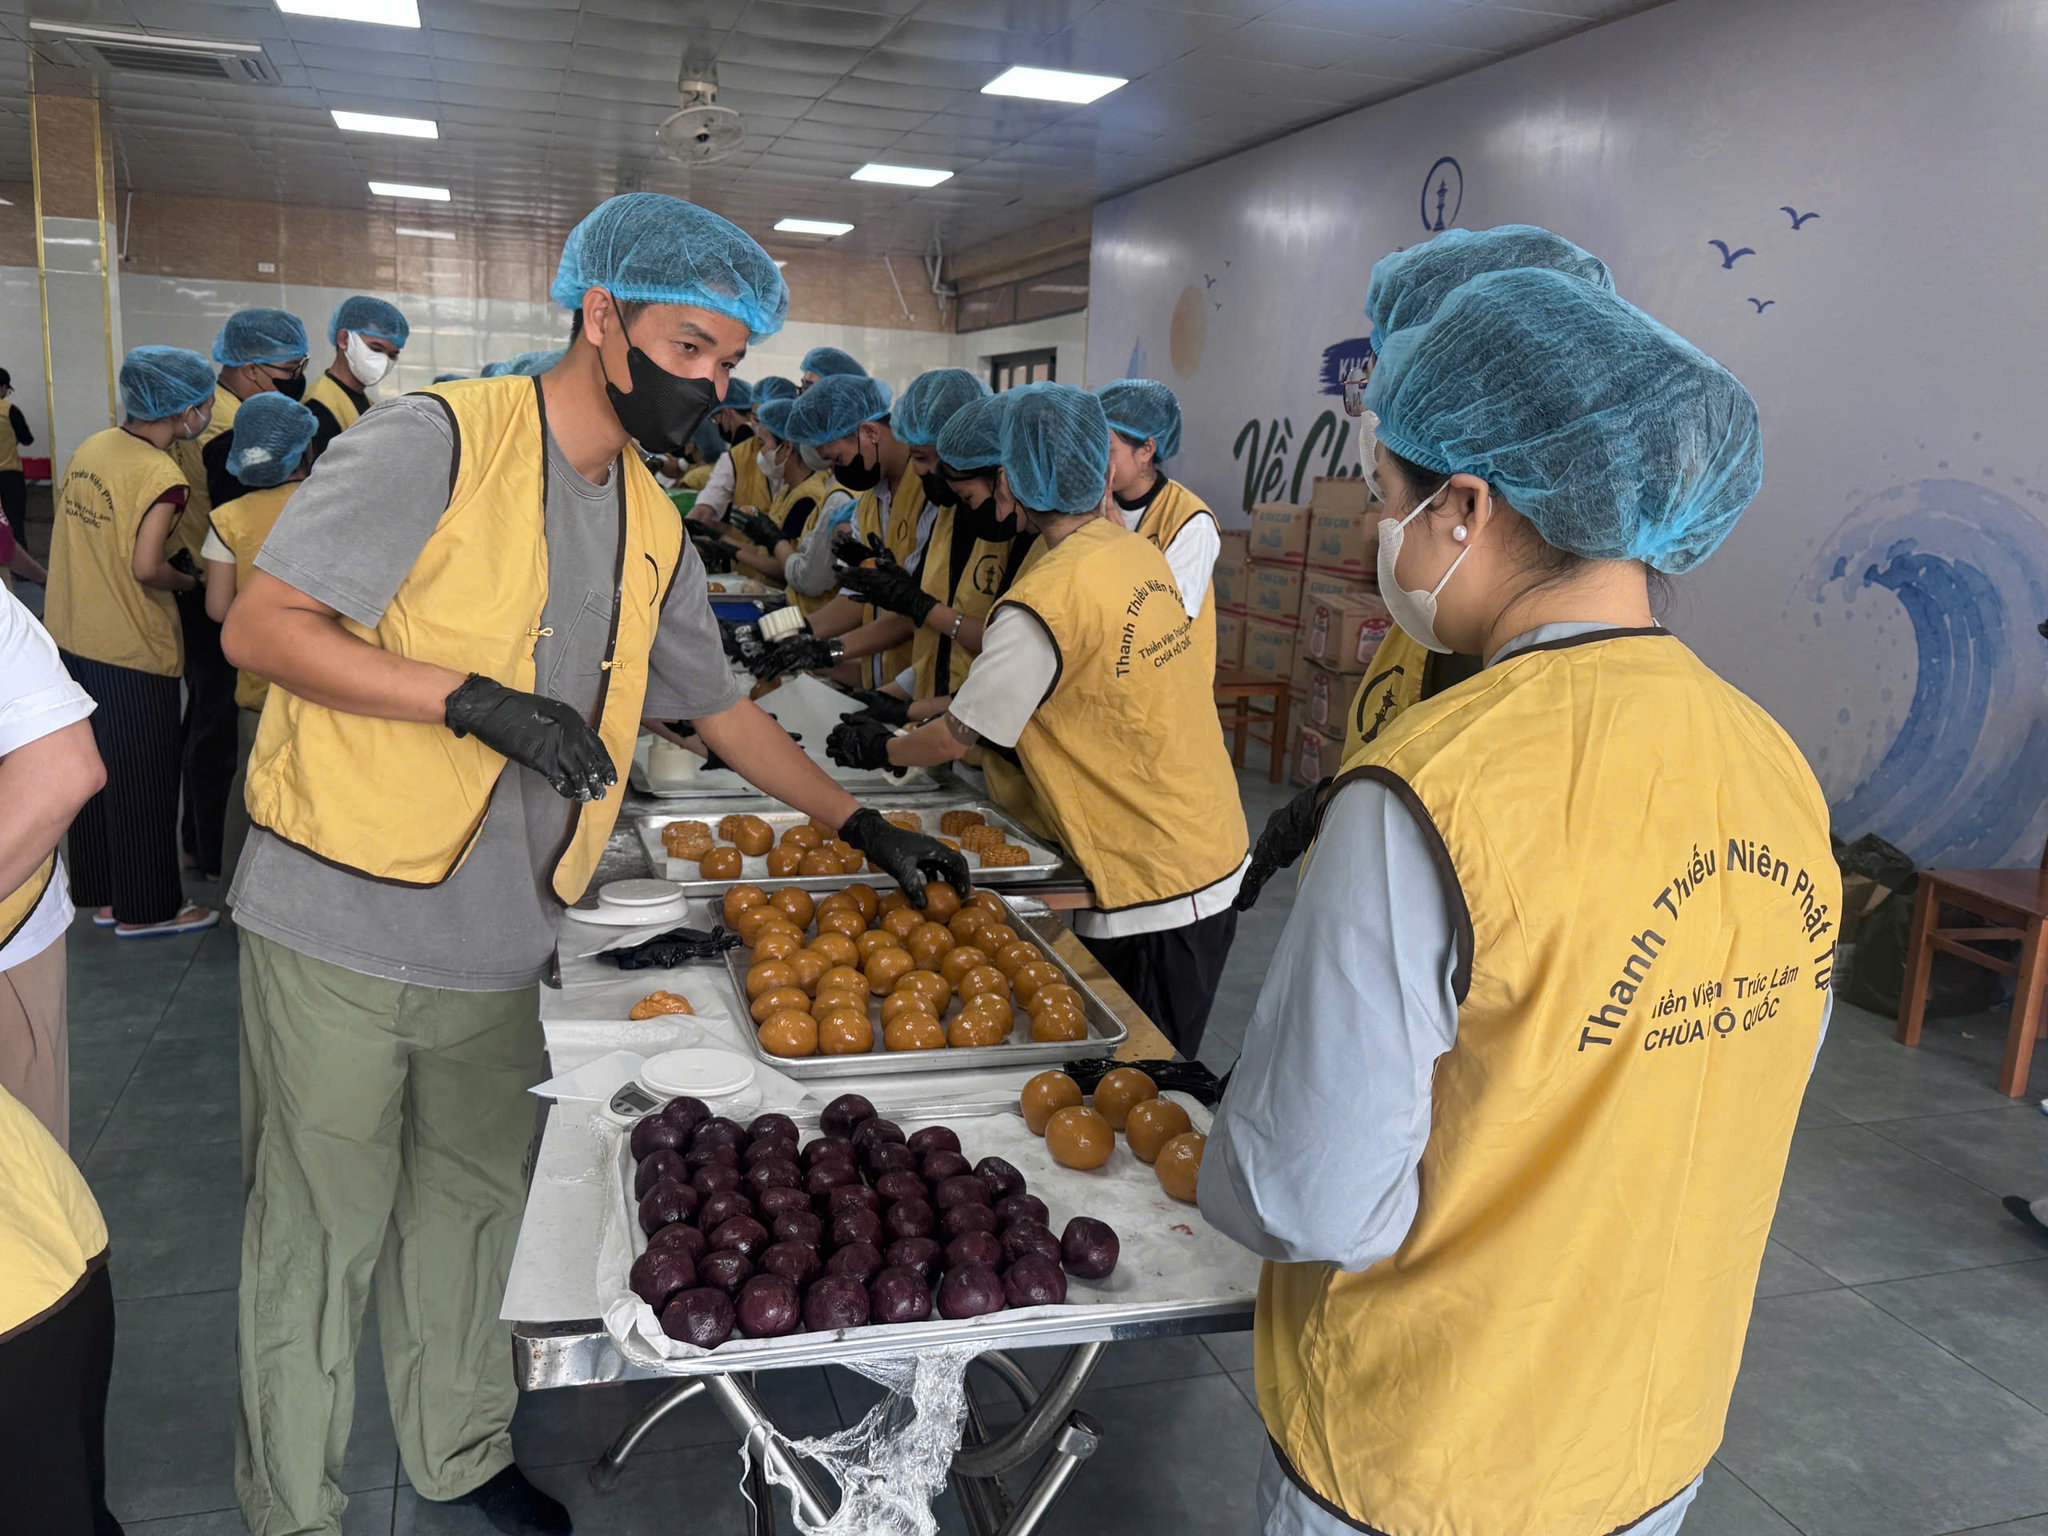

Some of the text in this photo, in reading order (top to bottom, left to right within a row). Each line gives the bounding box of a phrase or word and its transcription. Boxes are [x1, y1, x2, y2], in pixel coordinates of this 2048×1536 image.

[1233, 416, 1294, 516] Về
[1116, 622, 1135, 678] Thanh
[1127, 586, 1149, 617] Thiếu
[1145, 579, 1167, 593] Niên
[1138, 641, 1163, 659] Thiền
[1578, 929, 1666, 1051] Thanh
[1653, 843, 1716, 921] Thiếu
[1727, 838, 1789, 887] Niên
[1792, 868, 1833, 943] Phật
[1644, 991, 1780, 1051] CHÙA Ộ QUỐC
[1693, 980, 1722, 1008] Viện
[1734, 973, 1768, 1000] Trúc
[1770, 965, 1799, 989] Lâm
